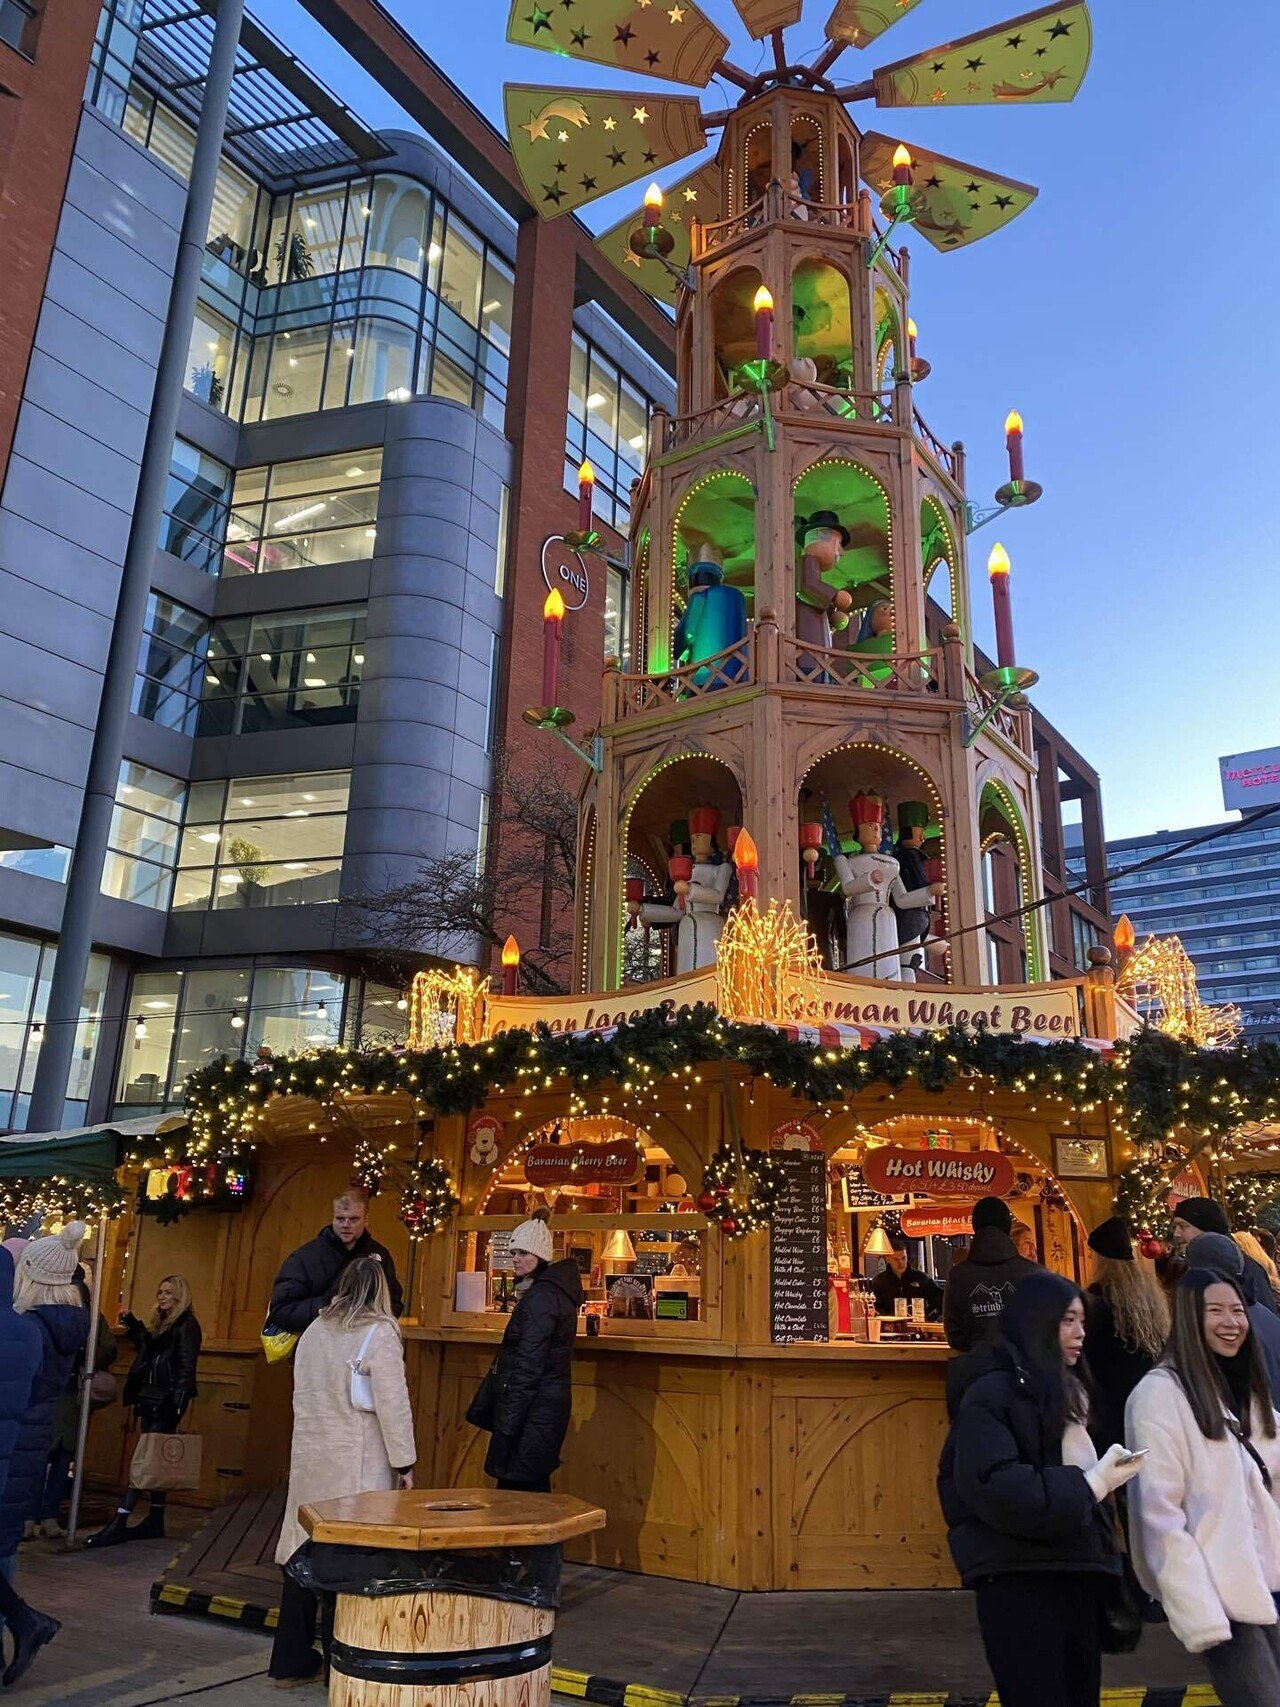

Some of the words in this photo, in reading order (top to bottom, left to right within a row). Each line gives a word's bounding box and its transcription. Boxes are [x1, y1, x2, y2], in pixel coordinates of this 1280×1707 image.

[560, 565, 586, 593] ONE
[907, 999, 1001, 1030] Wheat
[1011, 1005, 1074, 1034] Beer
[527, 1155, 569, 1167] Bavarian
[572, 1155, 603, 1167] Cherry
[605, 1155, 627, 1167] Beer
[886, 1159, 922, 1177] Hot
[927, 1160, 995, 1183] Whisky
[906, 1219, 941, 1228] Bavarian
[942, 1216, 967, 1226] Black
